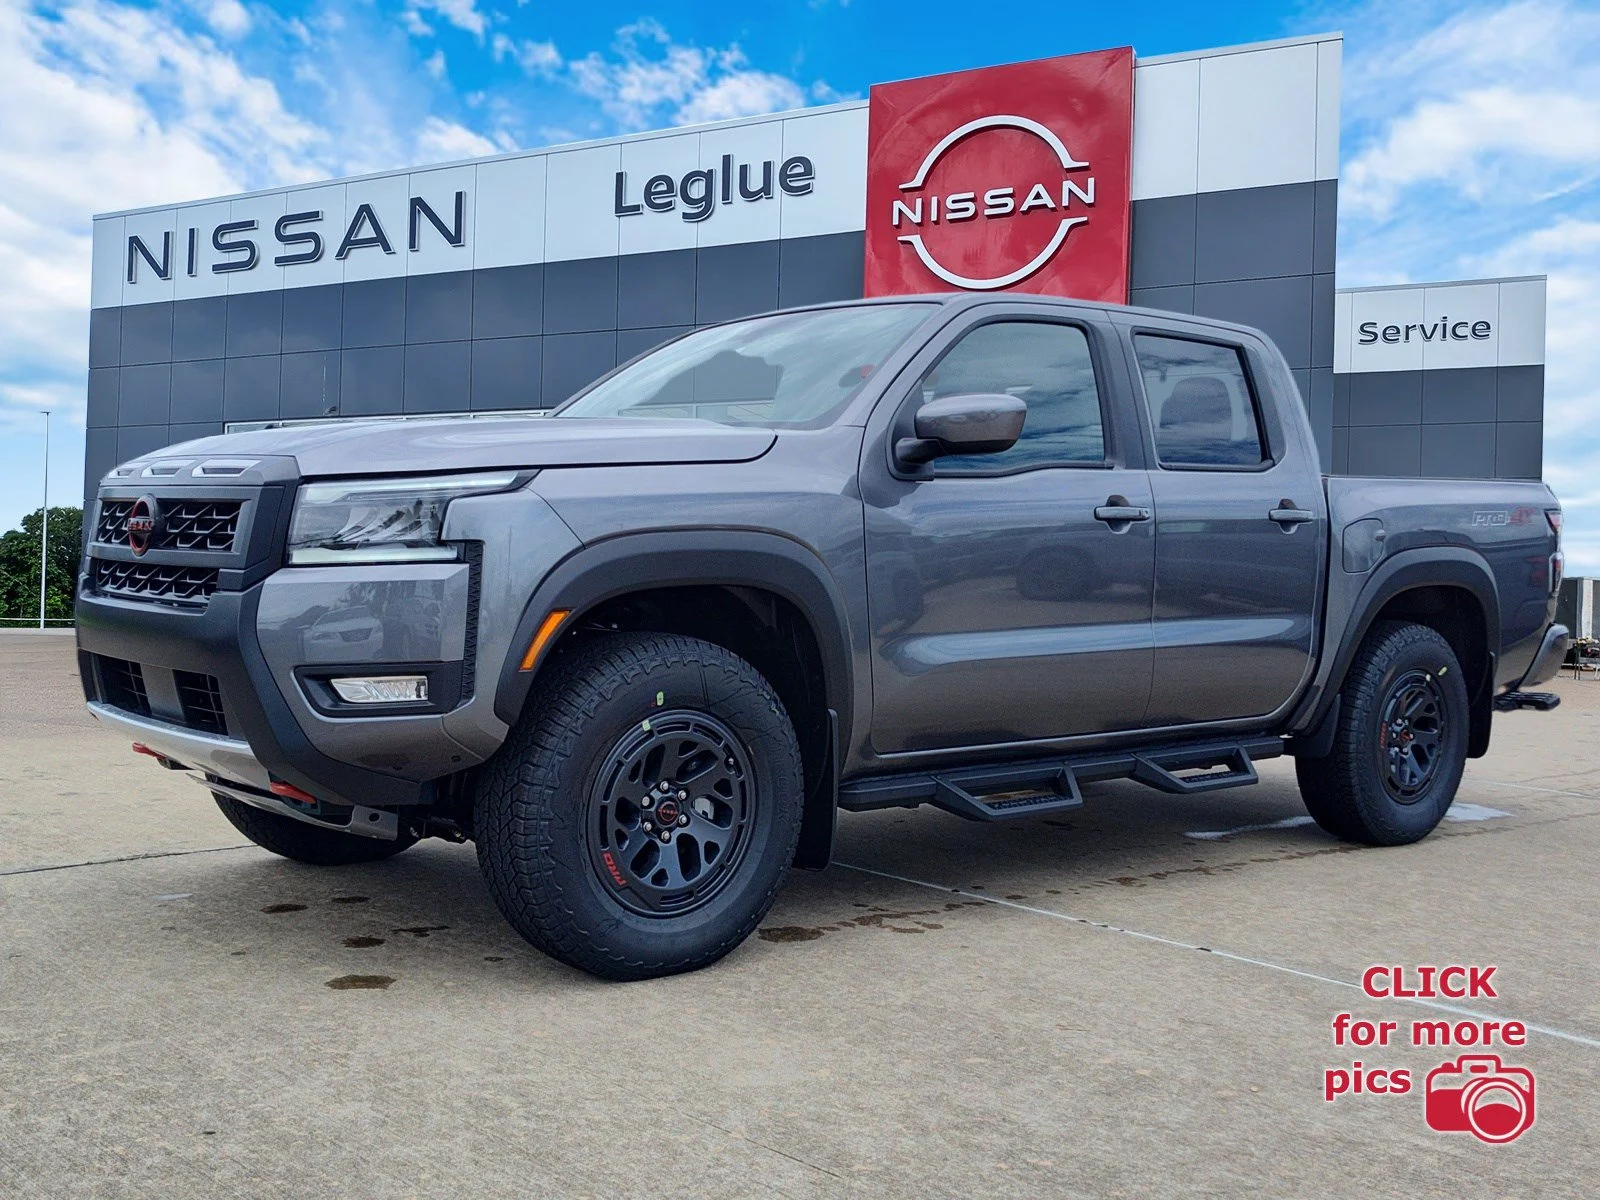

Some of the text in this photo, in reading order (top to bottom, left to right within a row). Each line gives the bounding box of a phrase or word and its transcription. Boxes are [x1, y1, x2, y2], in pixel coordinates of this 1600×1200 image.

[614, 153, 815, 222] Leglue
[892, 177, 1095, 226] NISSAN
[127, 191, 466, 284] NISSAN
[1358, 316, 1492, 345] Service
